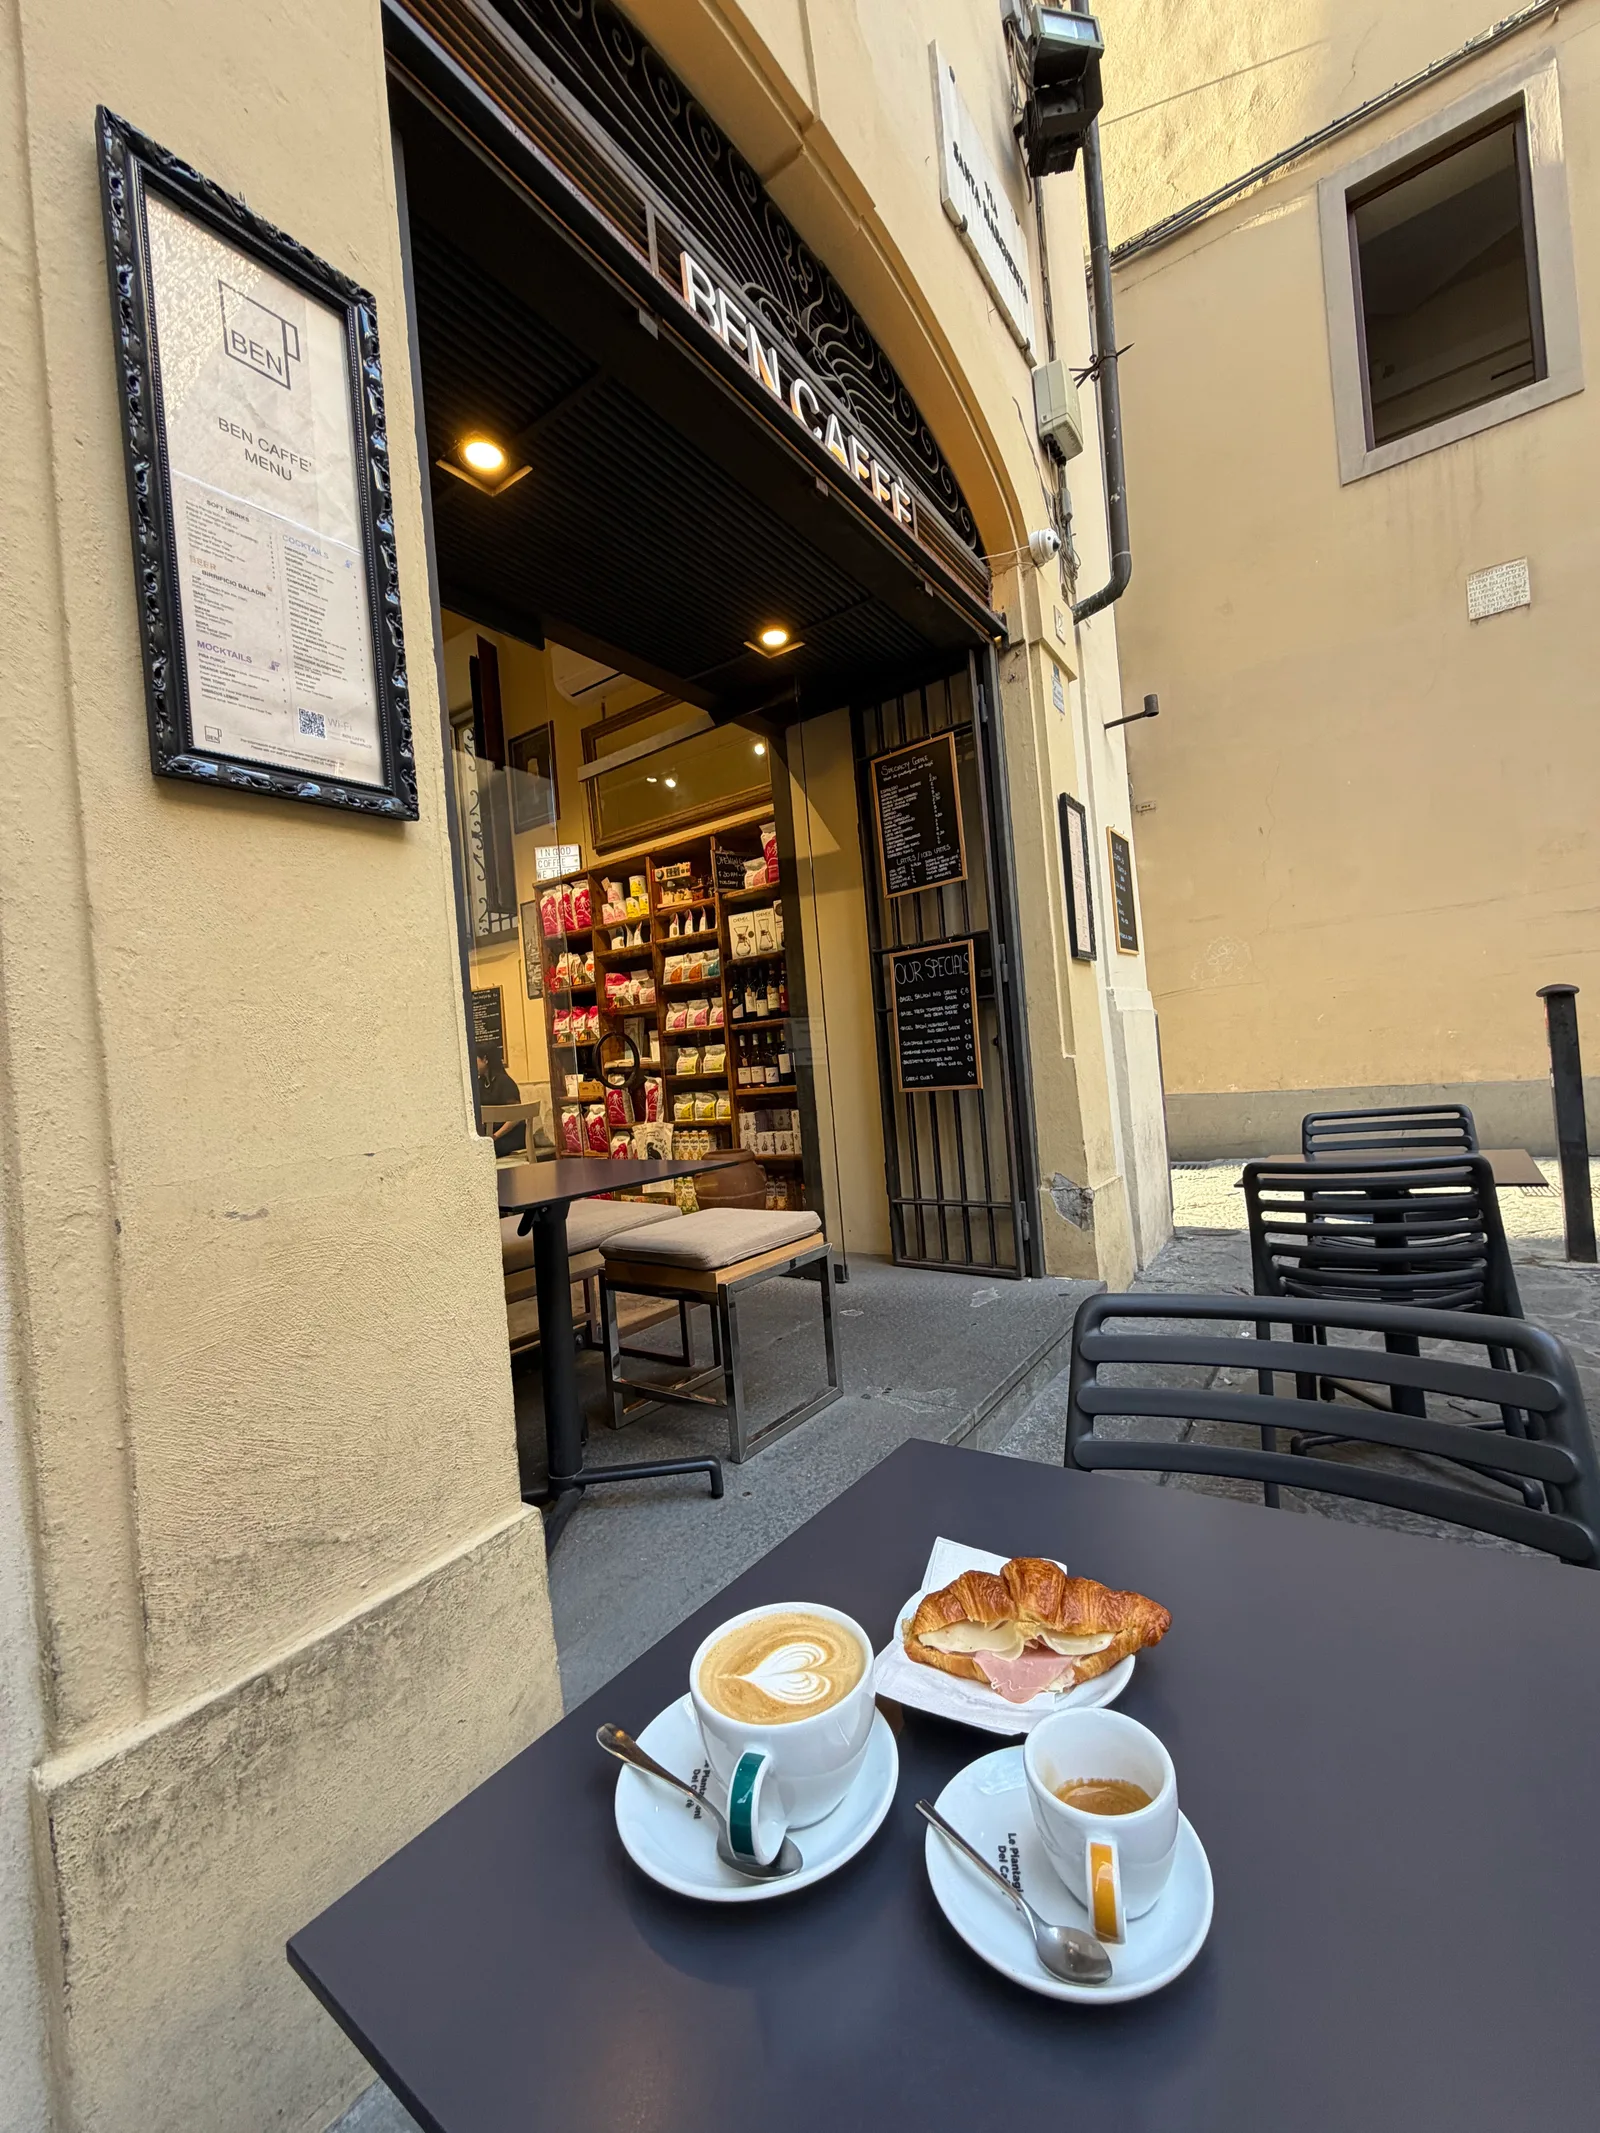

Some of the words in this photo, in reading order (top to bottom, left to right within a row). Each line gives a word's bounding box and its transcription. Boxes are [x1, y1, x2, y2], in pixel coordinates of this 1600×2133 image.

[953, 142, 981, 208] SANTA
[984, 181, 998, 219] VIA
[680, 251, 781, 400] BEN
[231, 329, 282, 376] BEN
[219, 418, 253, 444] BEN
[258, 438, 311, 472] CAFFE'
[245, 449, 292, 481] MENU
[207, 500, 223, 510] SOFT
[282, 534, 329, 559] COCKTAILS
[189, 555, 216, 570] BEER
[202, 570, 237, 586] BIRRIFICIO
[238, 583, 266, 597] BALADIN
[197, 640, 252, 663] MOCKTAILS
[328, 717, 352, 731] Wi-Fi
[540, 848, 550, 857] IN
[896, 855, 916, 865] LATTES
[934, 844, 951, 854] LATTES
[895, 961, 923, 984] OUR
[925, 952, 969, 978] SPECIALS
[691, 1769, 701, 1783] Del
[1008, 1833, 1016, 1845] Le
[998, 1846, 1008, 1862] Del
